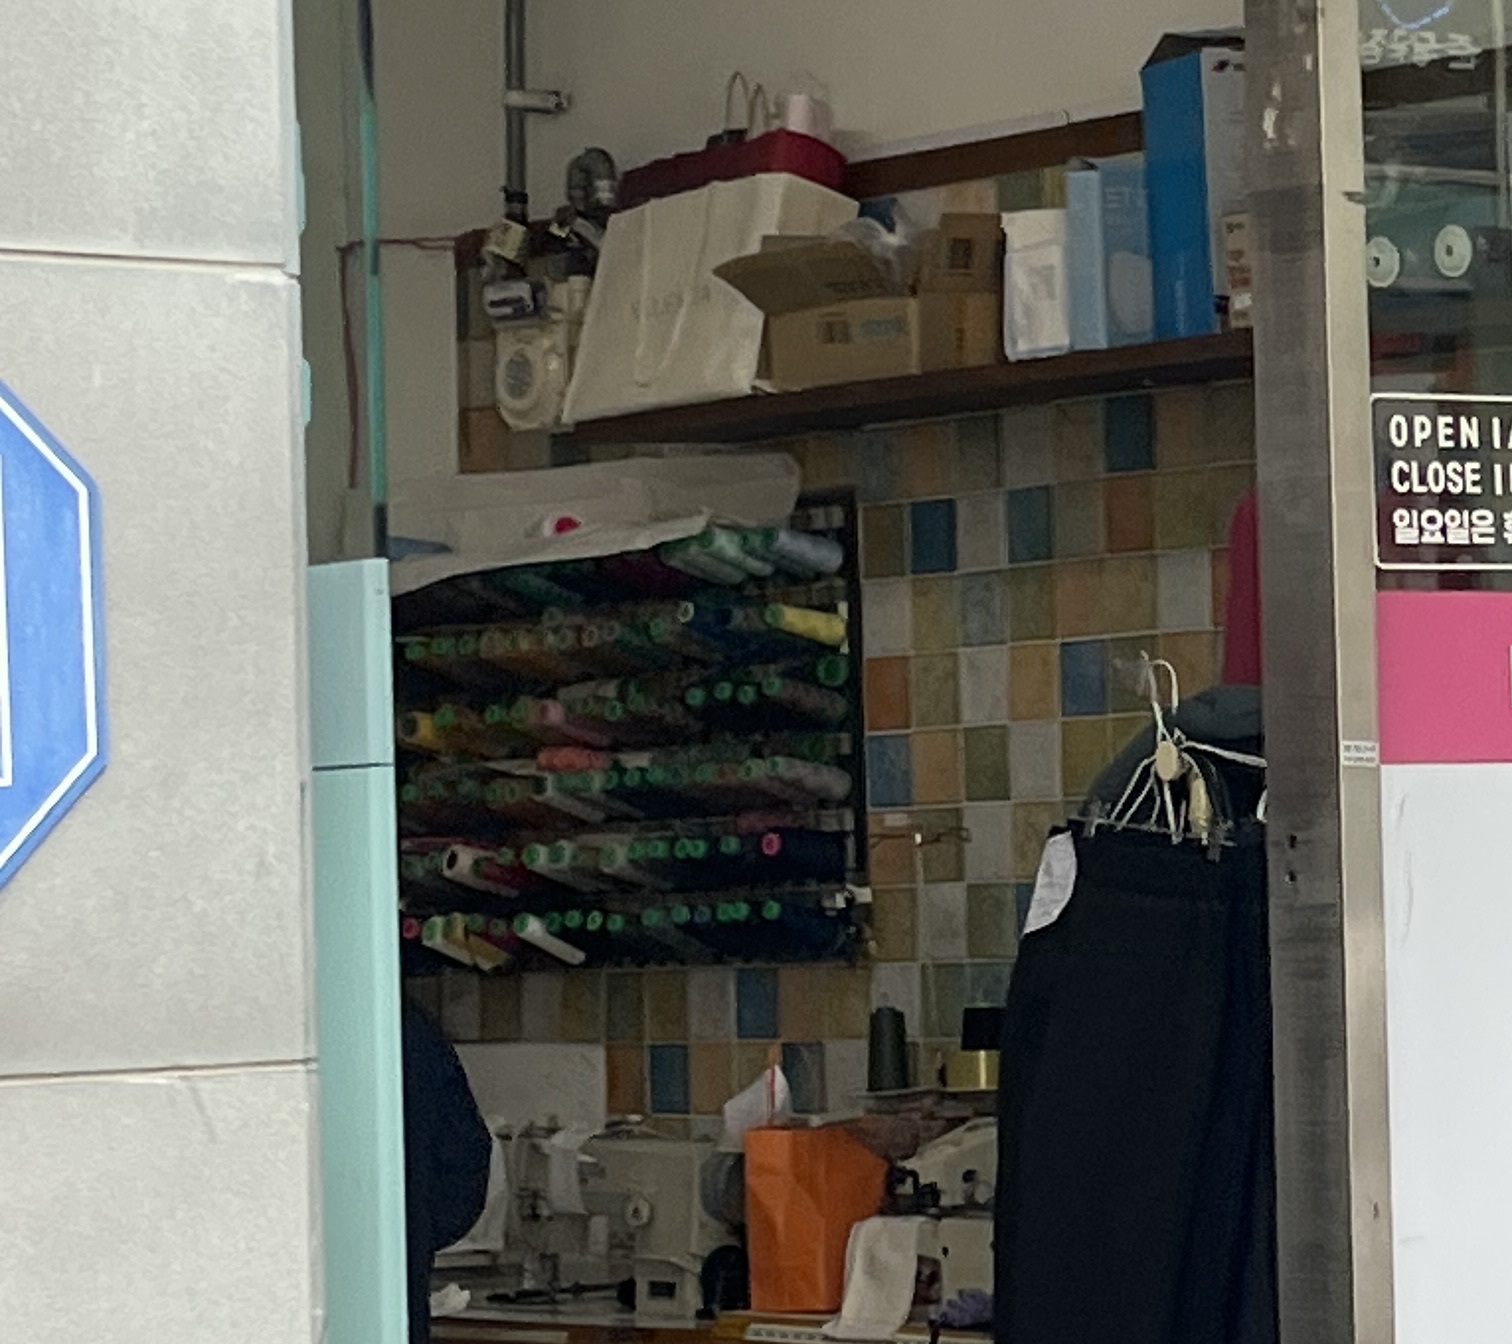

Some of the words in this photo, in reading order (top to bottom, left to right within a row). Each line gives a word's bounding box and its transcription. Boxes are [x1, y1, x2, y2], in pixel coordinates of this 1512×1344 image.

[1389, 415, 1480, 451] OPEN
[1391, 461, 1482, 496] CLOSE
[1392, 509, 1496, 546] 일요일은
